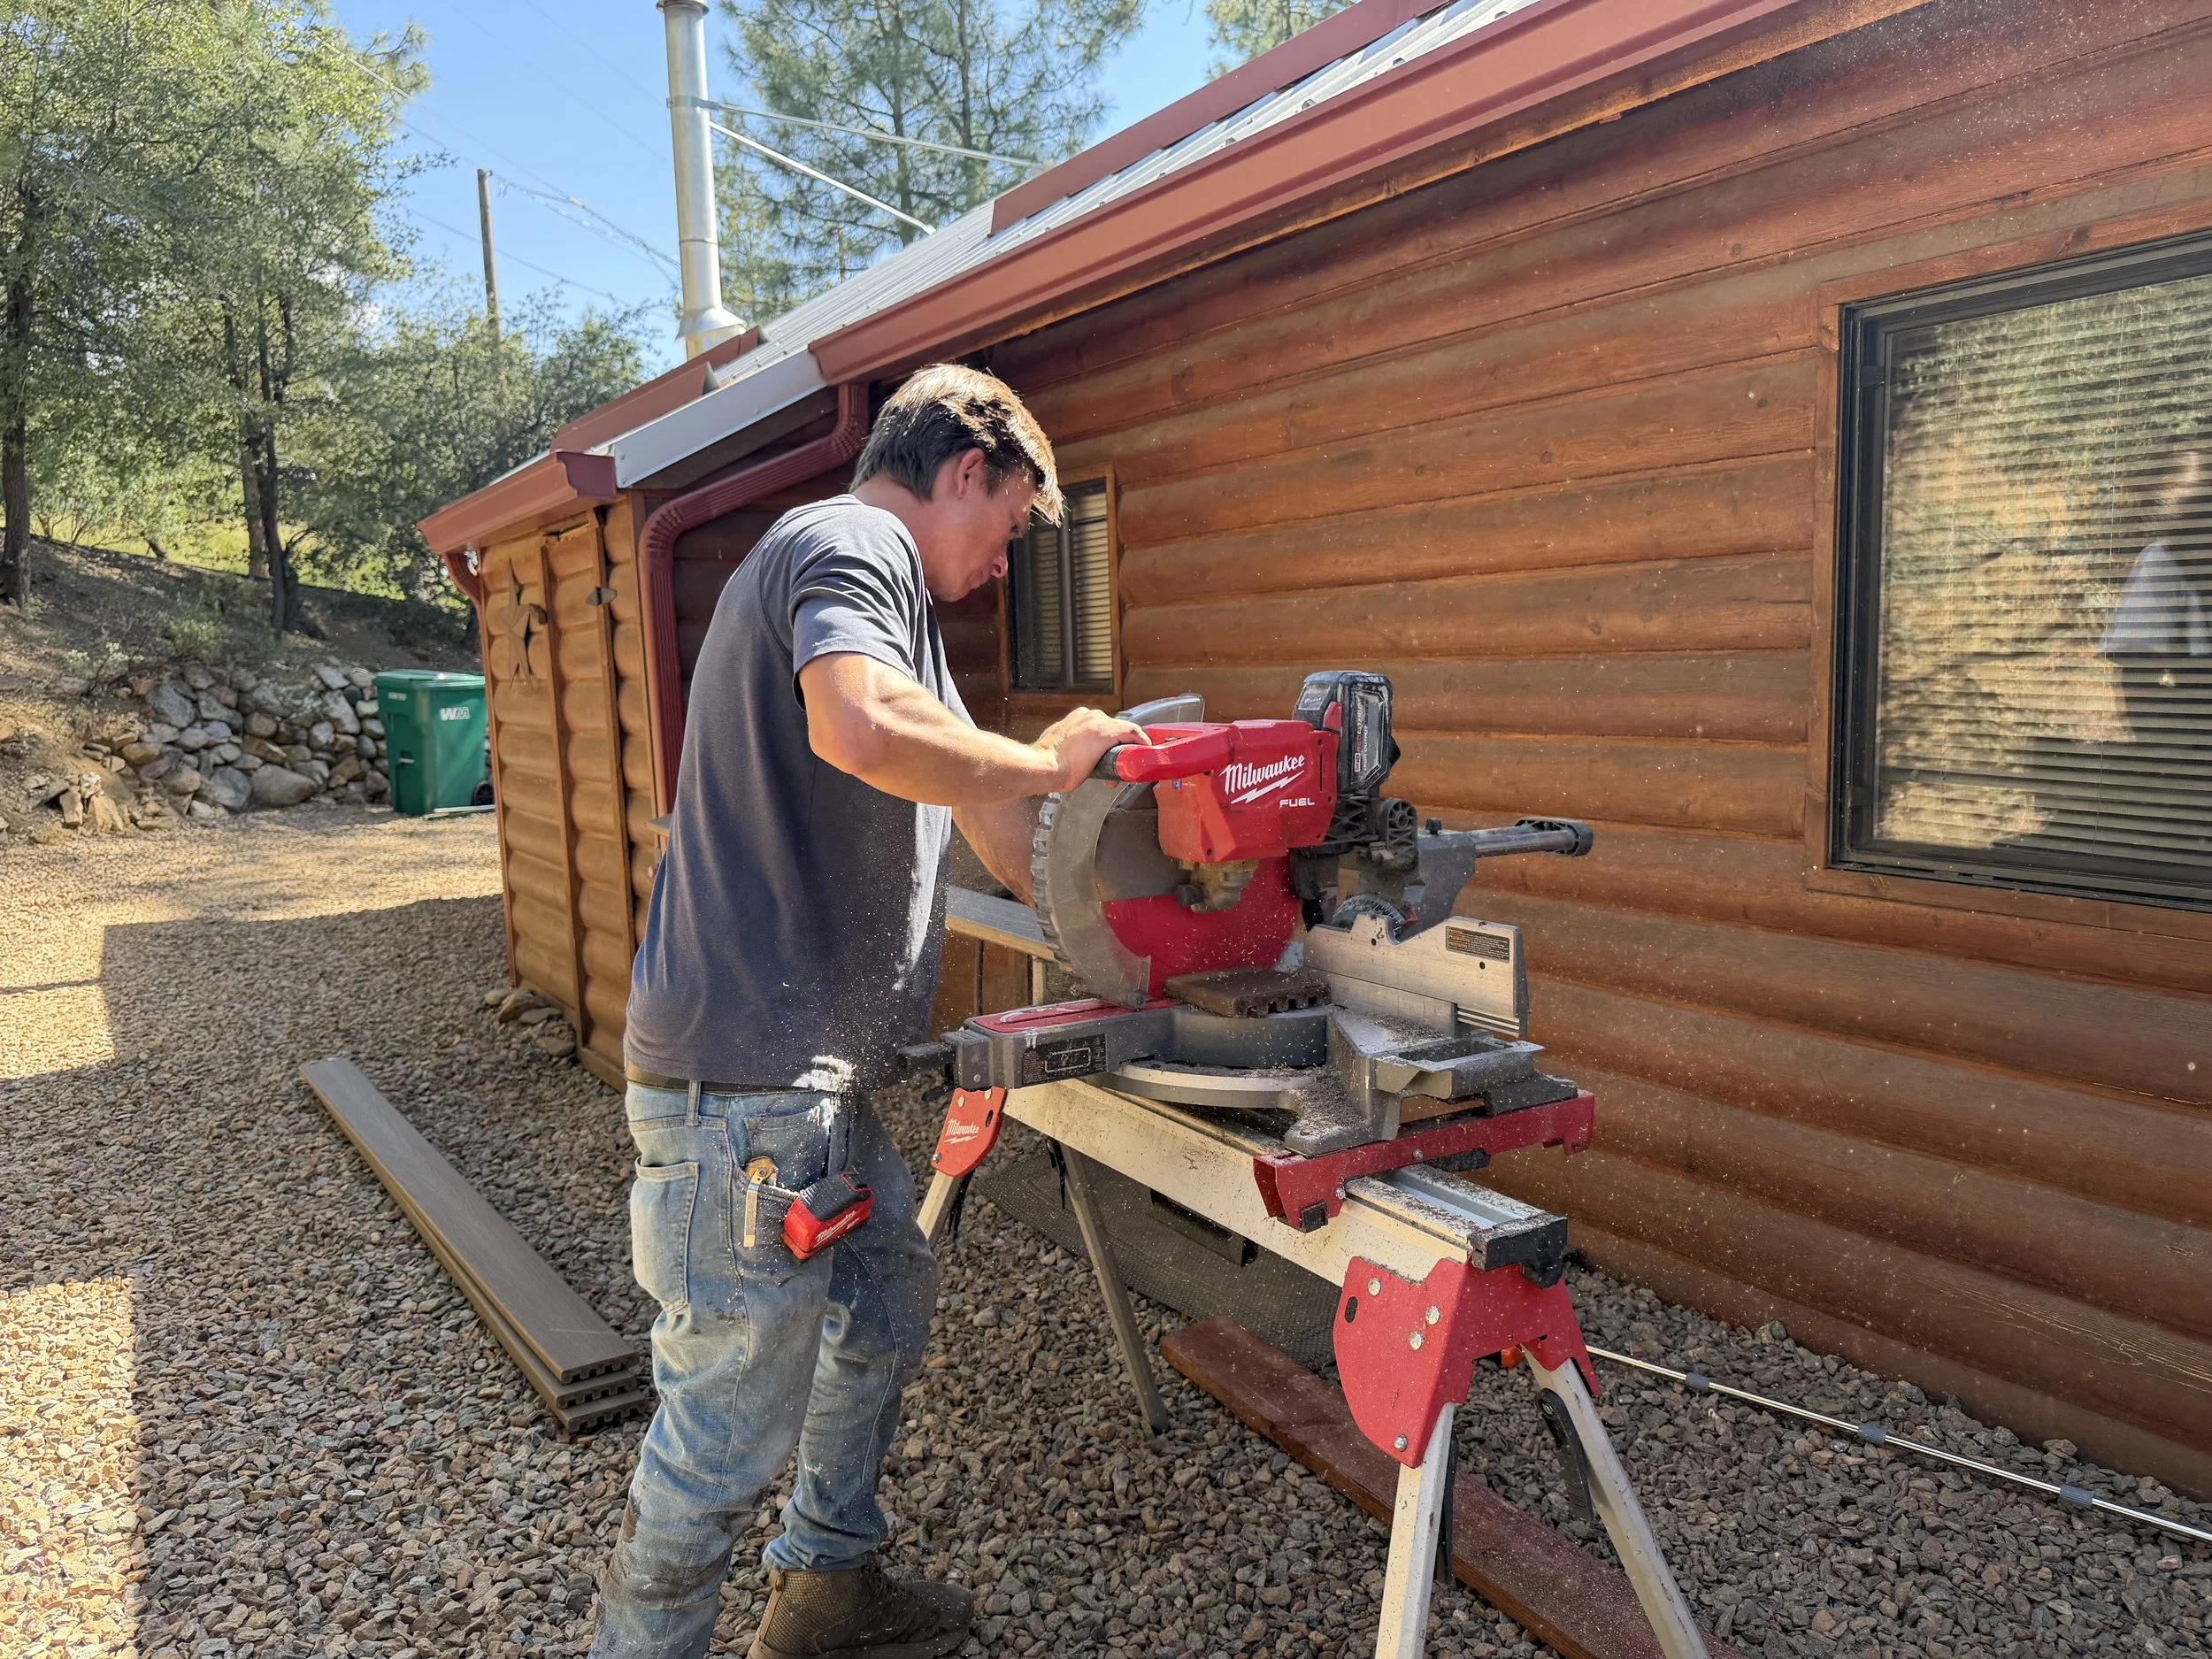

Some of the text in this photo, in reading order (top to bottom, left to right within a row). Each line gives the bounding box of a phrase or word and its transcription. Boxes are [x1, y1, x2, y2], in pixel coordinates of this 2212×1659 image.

[1218, 754, 1305, 795] Milwaukee
[1279, 797, 1316, 808] FUEL
[946, 1118, 980, 1137] Milwaukee
